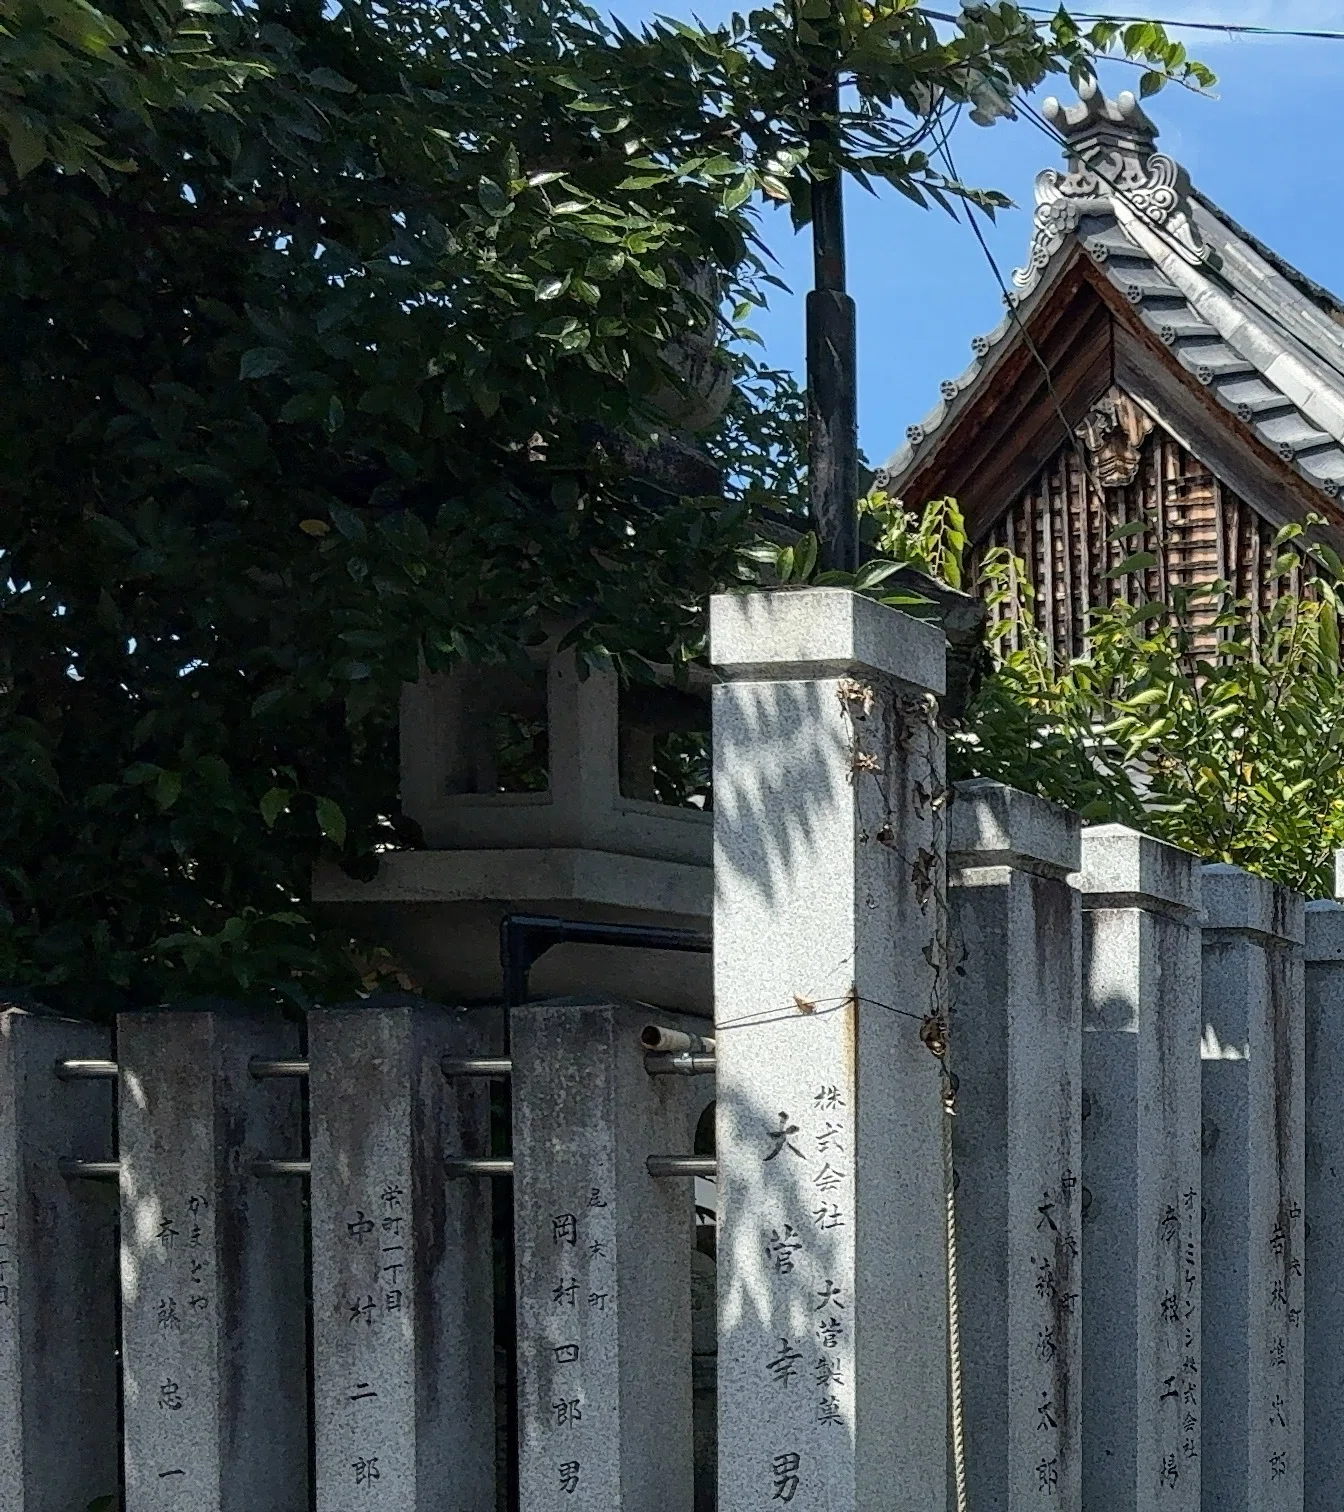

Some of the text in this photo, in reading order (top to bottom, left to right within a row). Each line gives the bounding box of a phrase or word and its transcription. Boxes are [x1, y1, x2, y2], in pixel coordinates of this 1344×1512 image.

[813, 1084, 847, 1231] 株式会社
[346, 1210, 381, 1484] 中村二郎
[551, 1212, 582, 1494] 岡村四郎男
